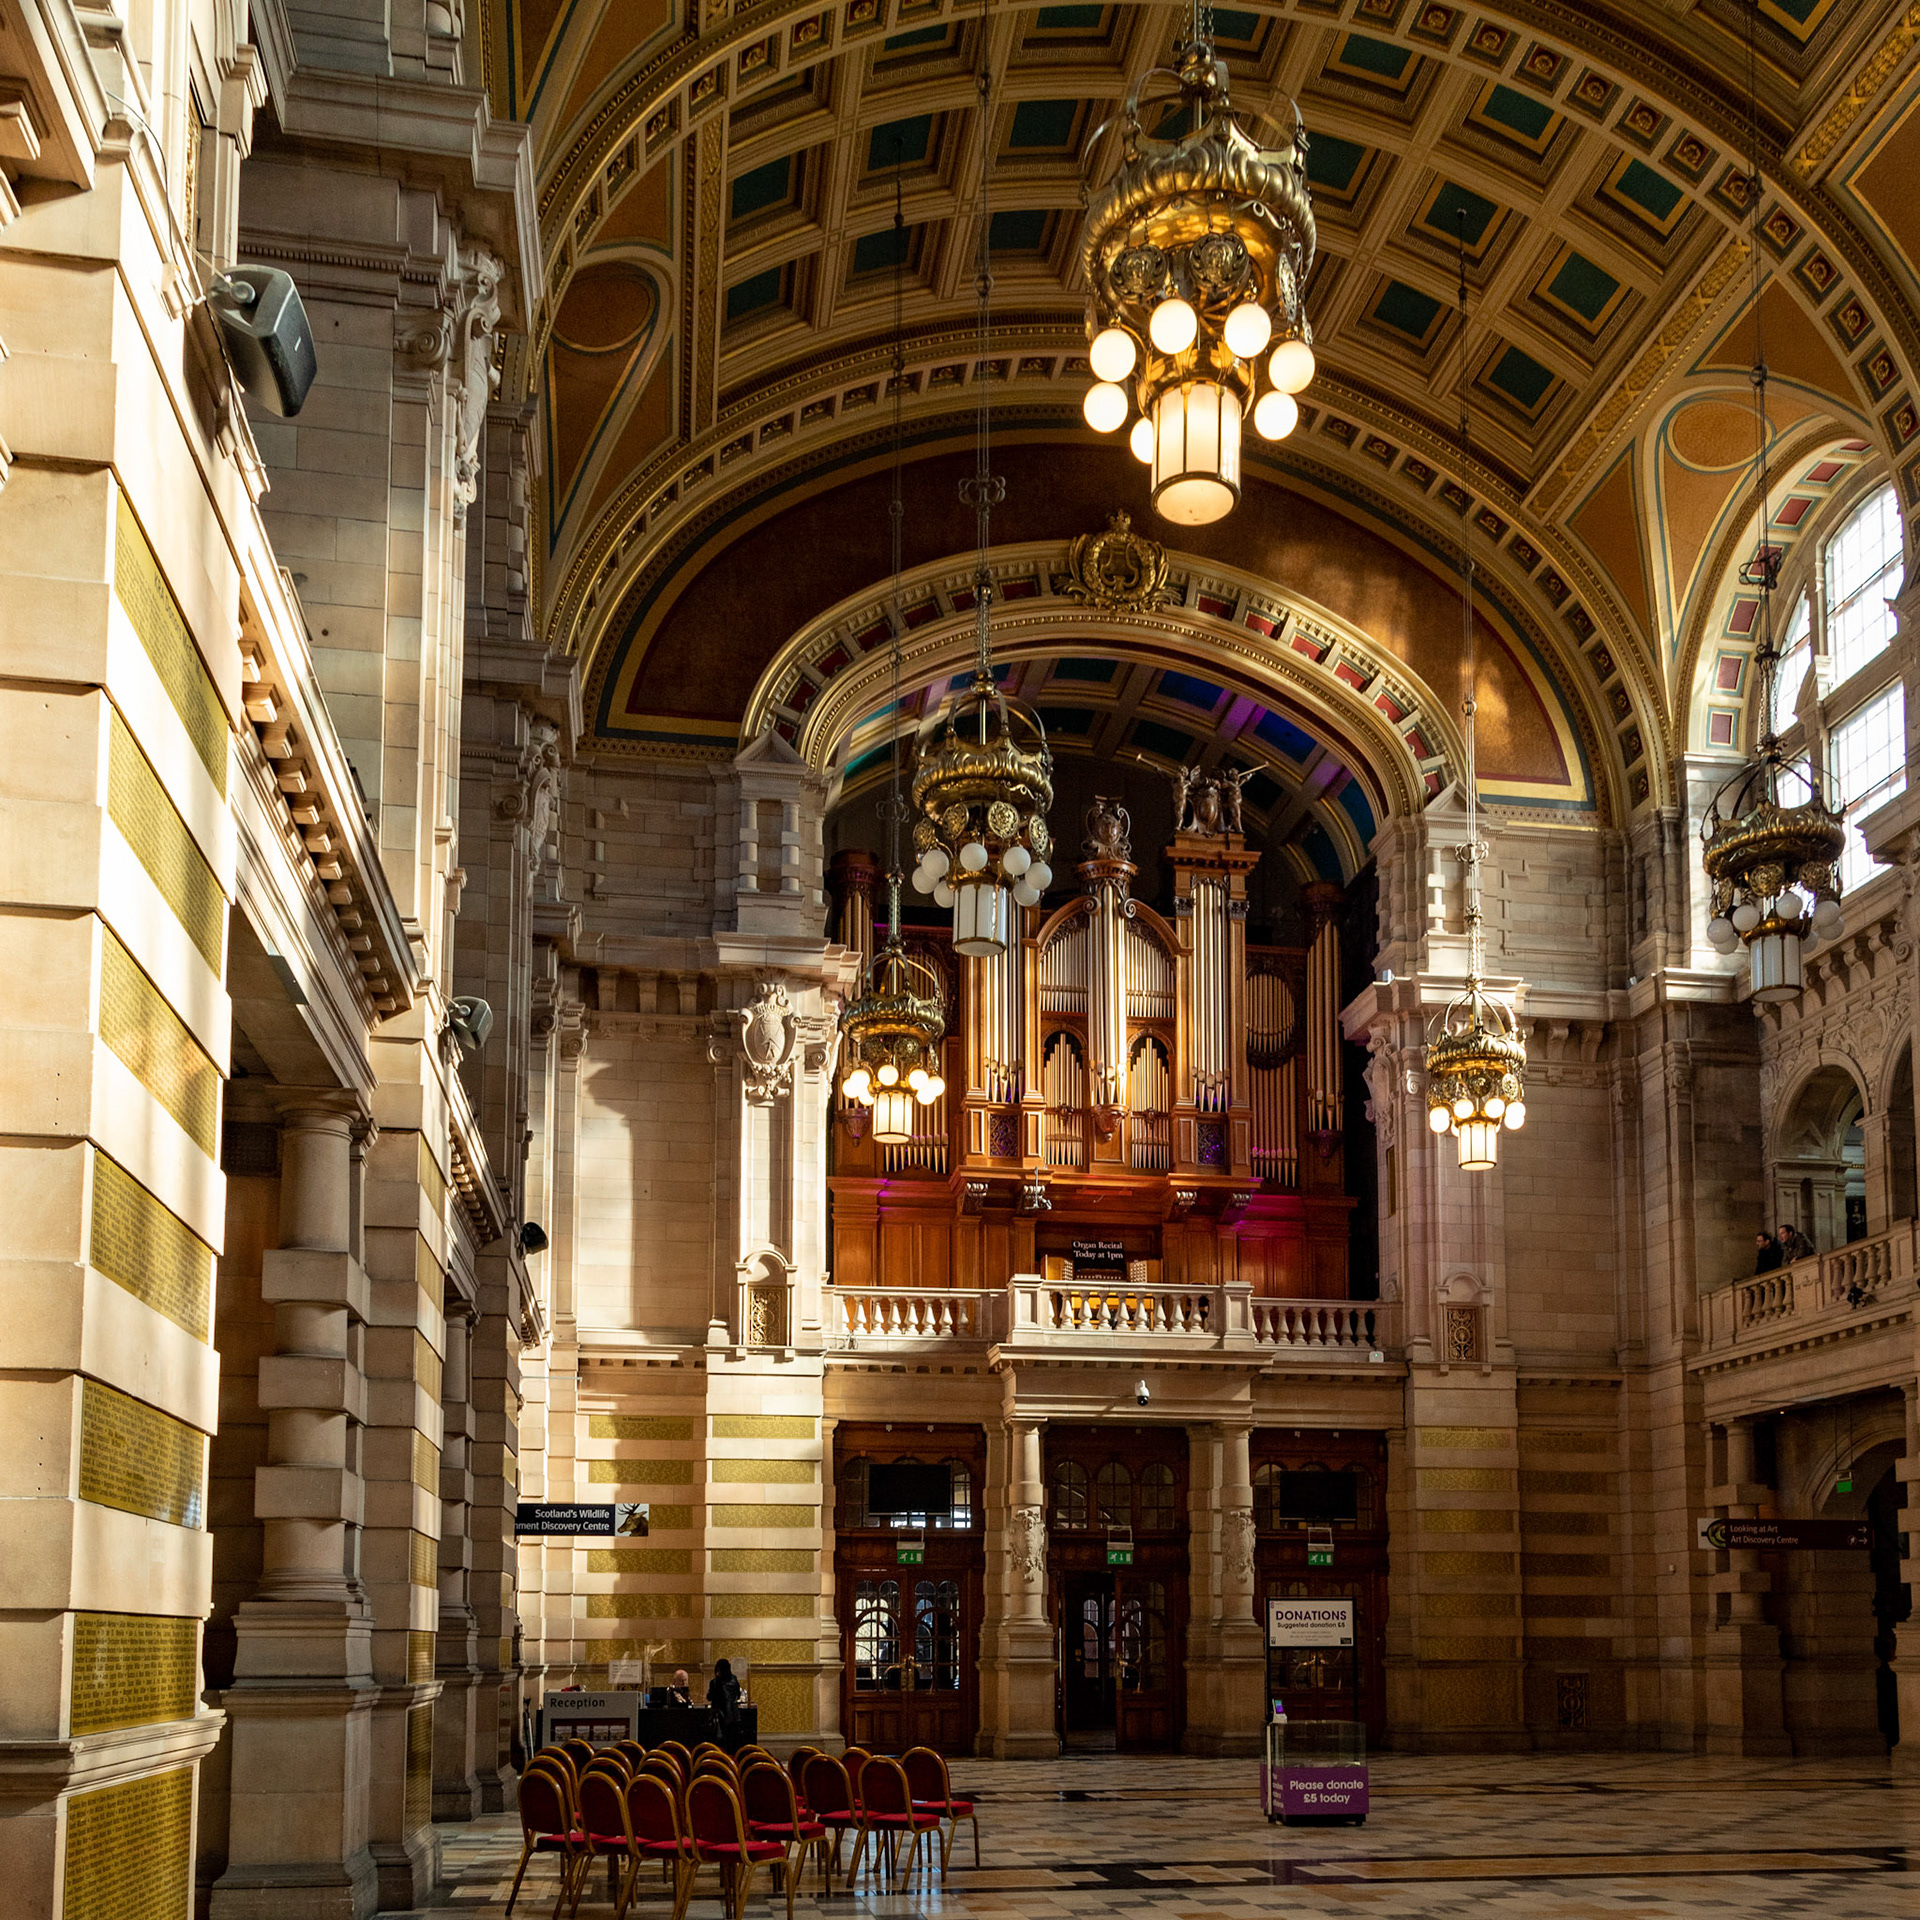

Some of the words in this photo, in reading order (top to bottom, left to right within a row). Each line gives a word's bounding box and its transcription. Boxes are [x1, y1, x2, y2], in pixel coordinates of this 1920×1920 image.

[1073, 1241, 1096, 1249] Organ
[1074, 1250, 1096, 1259] Today
[1107, 1251, 1124, 1260] 1pm
[535, 1509, 577, 1518] Scotland's
[579, 1509, 610, 1518] Wildlife
[541, 1521, 581, 1532] Discovery
[583, 1521, 610, 1531] Centre
[1730, 1525, 1758, 1534] Looking
[1767, 1525, 1778, 1533] Art
[1730, 1536, 1742, 1544] Art
[1743, 1536, 1775, 1545] Discovery
[1776, 1536, 1799, 1544] Centre
[1275, 1610, 1347, 1621] DONATIONS
[550, 1698, 605, 1709] Reception
[1289, 1780, 1324, 1790] Please
[1326, 1779, 1364, 1790] donate
[1303, 1793, 1318, 1803] £5
[1320, 1793, 1351, 1805] today
